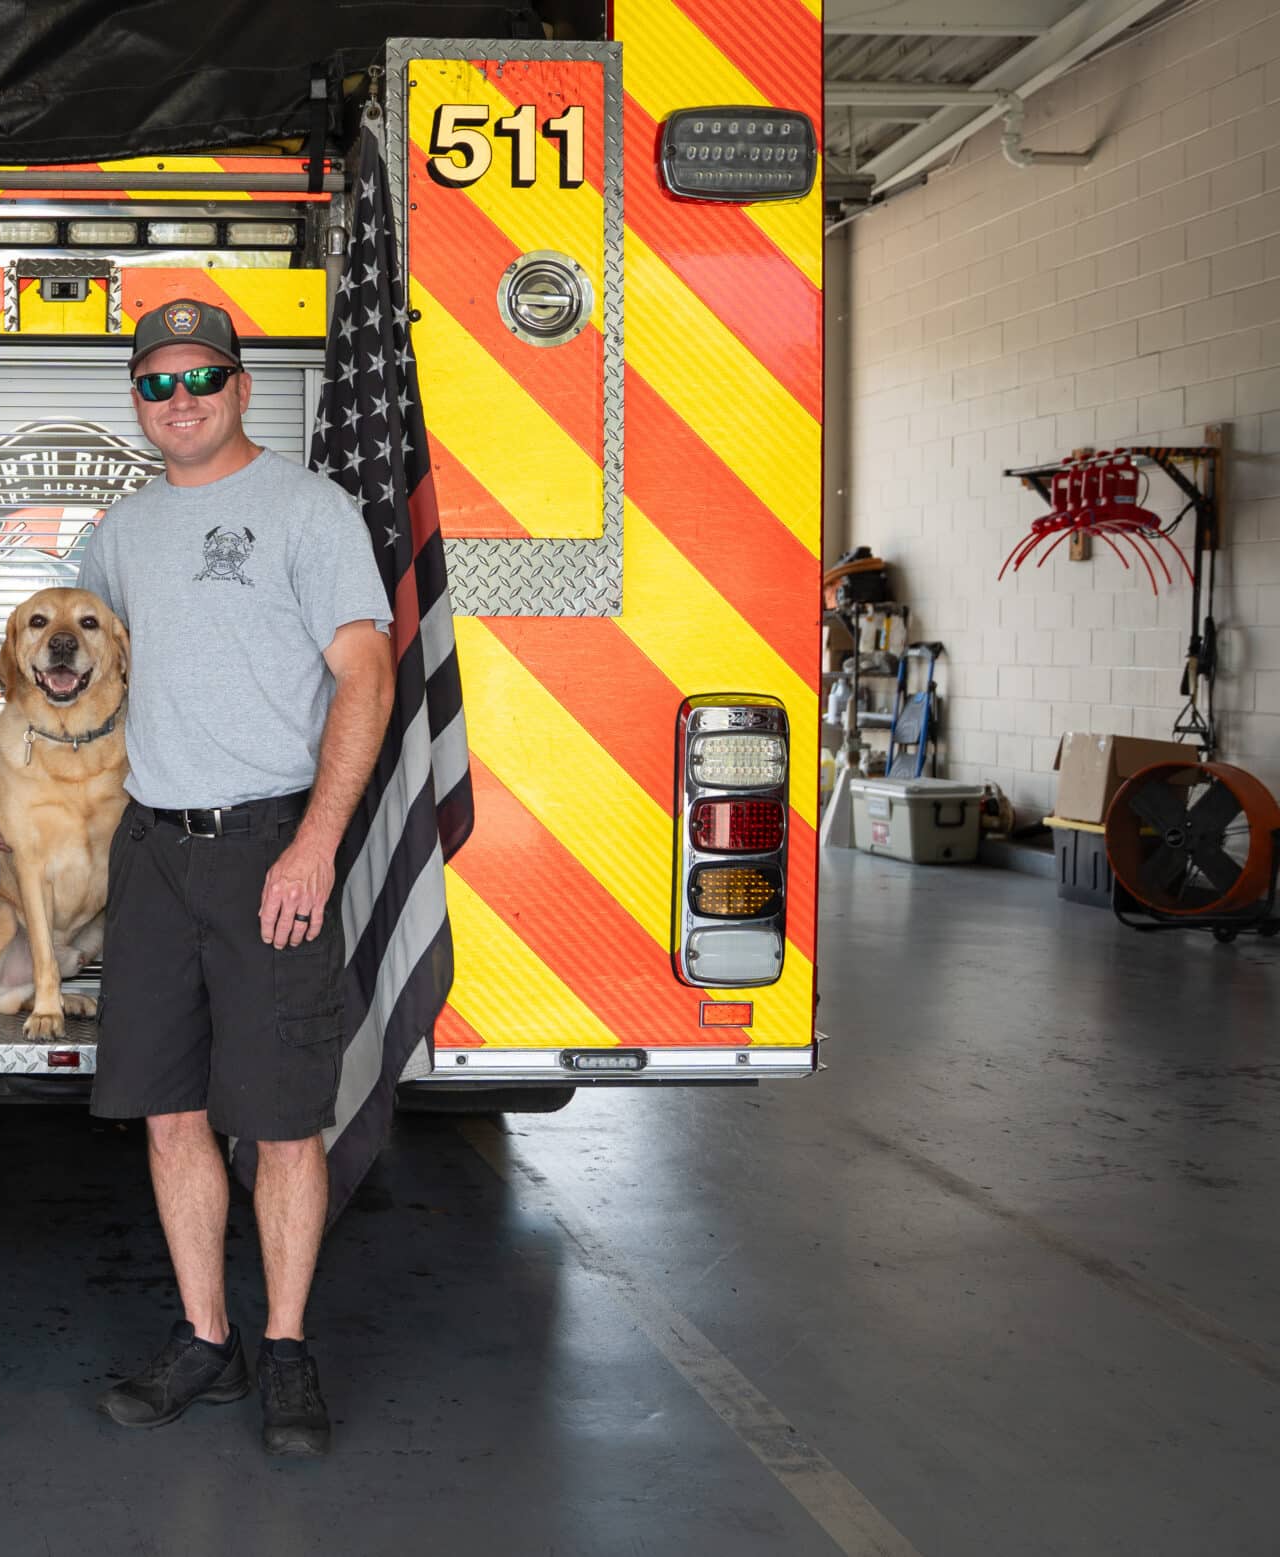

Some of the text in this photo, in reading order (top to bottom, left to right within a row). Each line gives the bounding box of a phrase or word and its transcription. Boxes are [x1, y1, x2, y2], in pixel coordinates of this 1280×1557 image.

[426, 104, 585, 189] 511
[74, 451, 157, 491] RIVE
[43, 482, 123, 505] DISTRIC
